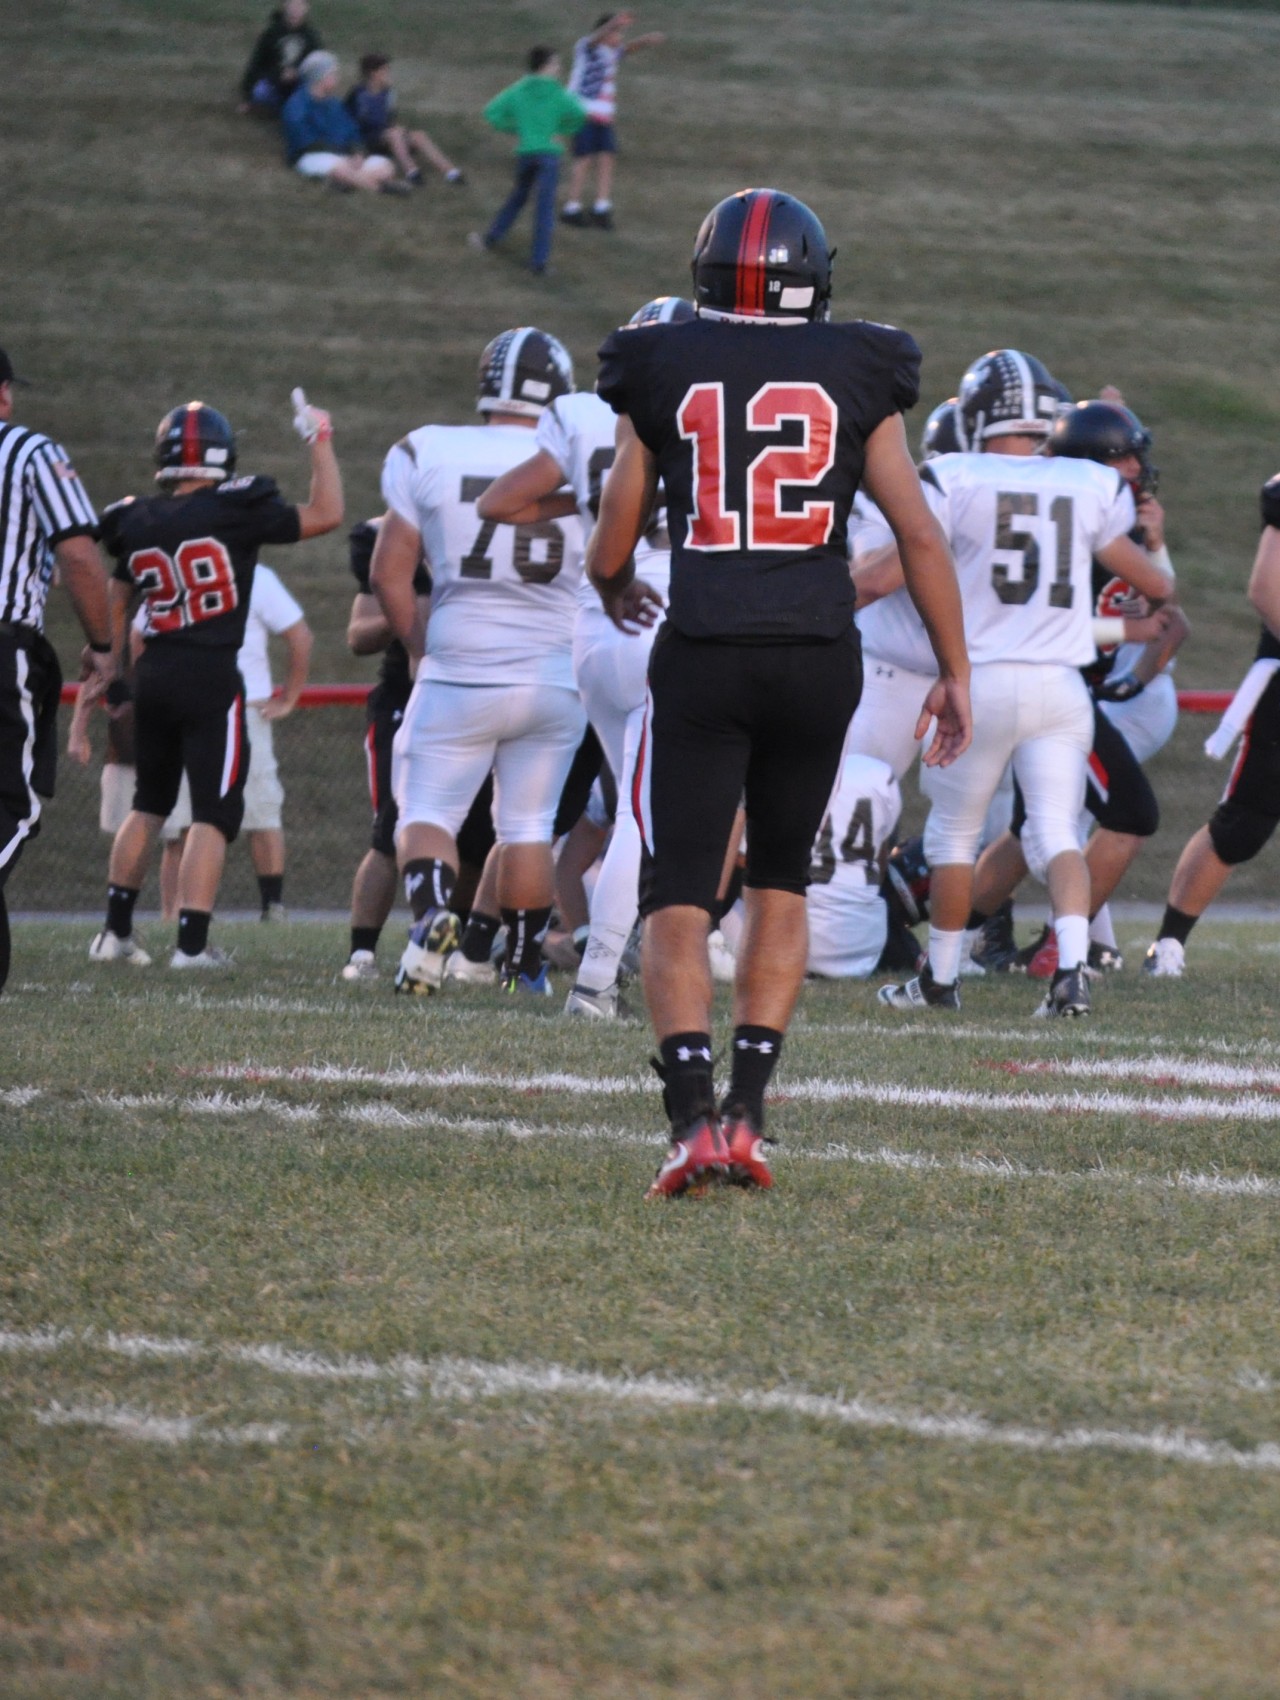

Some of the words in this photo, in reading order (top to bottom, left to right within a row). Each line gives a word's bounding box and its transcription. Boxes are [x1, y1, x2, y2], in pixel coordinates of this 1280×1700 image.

[676, 382, 838, 550] 12
[130, 536, 239, 635] 28
[459, 475, 565, 584] 76
[992, 491, 1075, 609] 51
